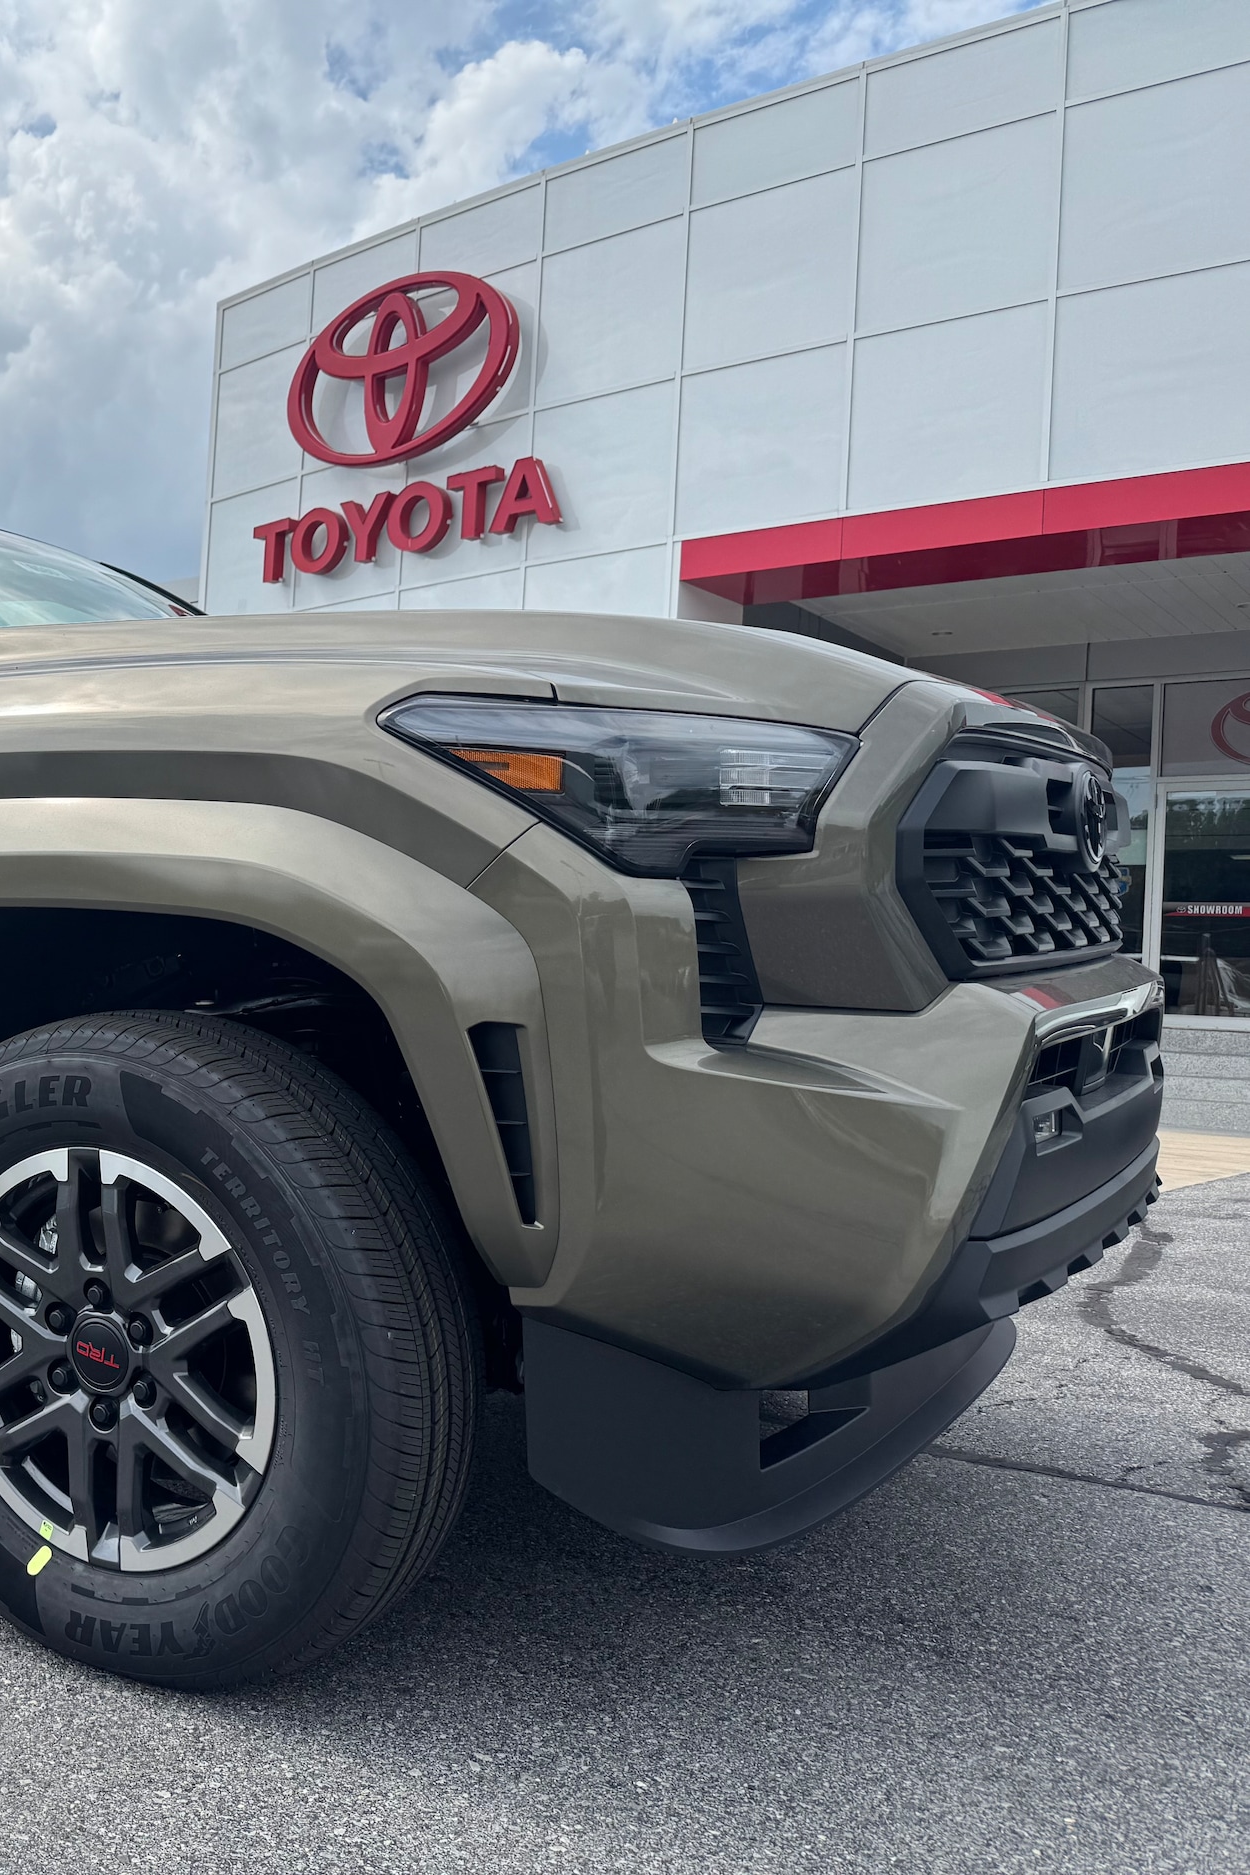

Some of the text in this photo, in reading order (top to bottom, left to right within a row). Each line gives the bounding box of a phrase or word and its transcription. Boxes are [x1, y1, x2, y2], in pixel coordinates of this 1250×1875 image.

[253, 456, 564, 583] TOYOTA
[1187, 905, 1243, 915] SHOWROOM
[200, 1147, 310, 1315] TERRITORY
[76, 1341, 120, 1369] TRD
